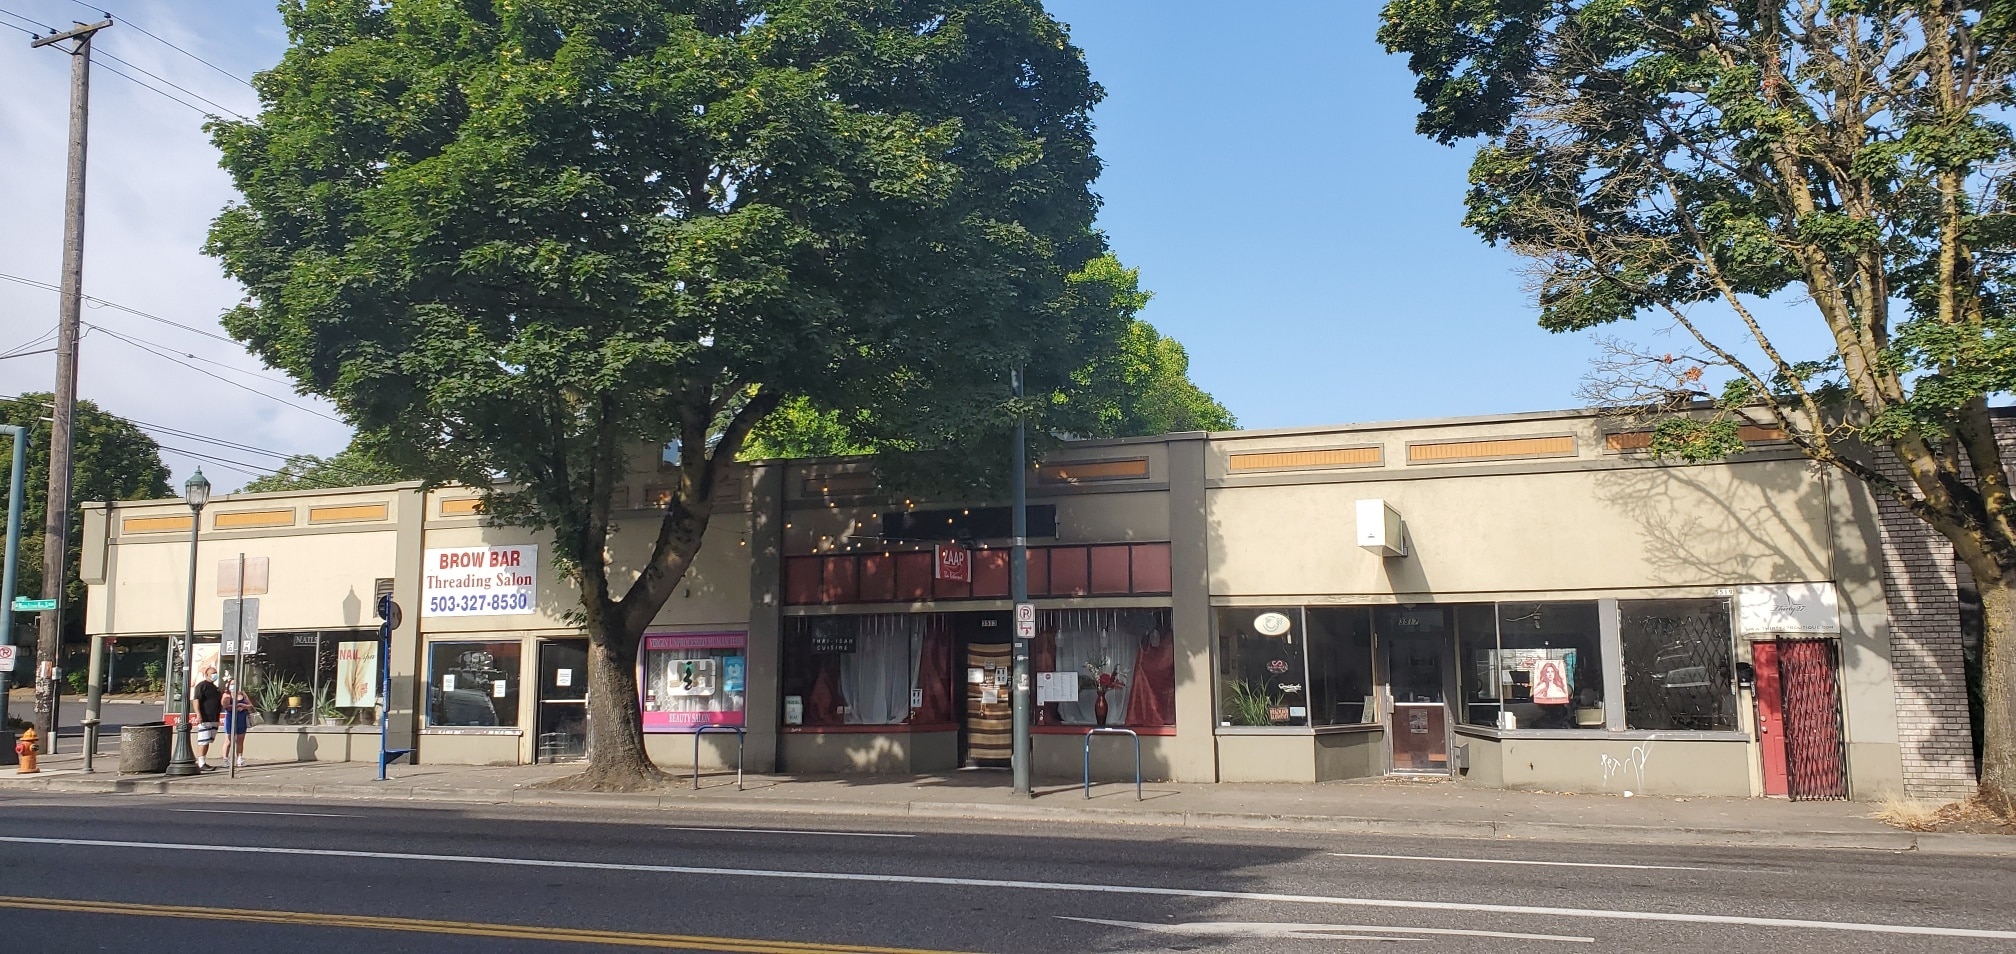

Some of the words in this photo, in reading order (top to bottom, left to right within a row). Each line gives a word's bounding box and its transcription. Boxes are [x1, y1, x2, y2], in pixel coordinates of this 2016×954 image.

[440, 552, 485, 569] BROW
[490, 550, 521, 568] BAR
[943, 549, 964, 566] ZAAP
[427, 574, 491, 590] Threading
[496, 572, 532, 587] Salon
[430, 593, 527, 613] 503-327-8530
[340, 649, 361, 660] NAIL
[669, 713, 690, 723] BEAUTY
[691, 713, 710, 723] SALON
